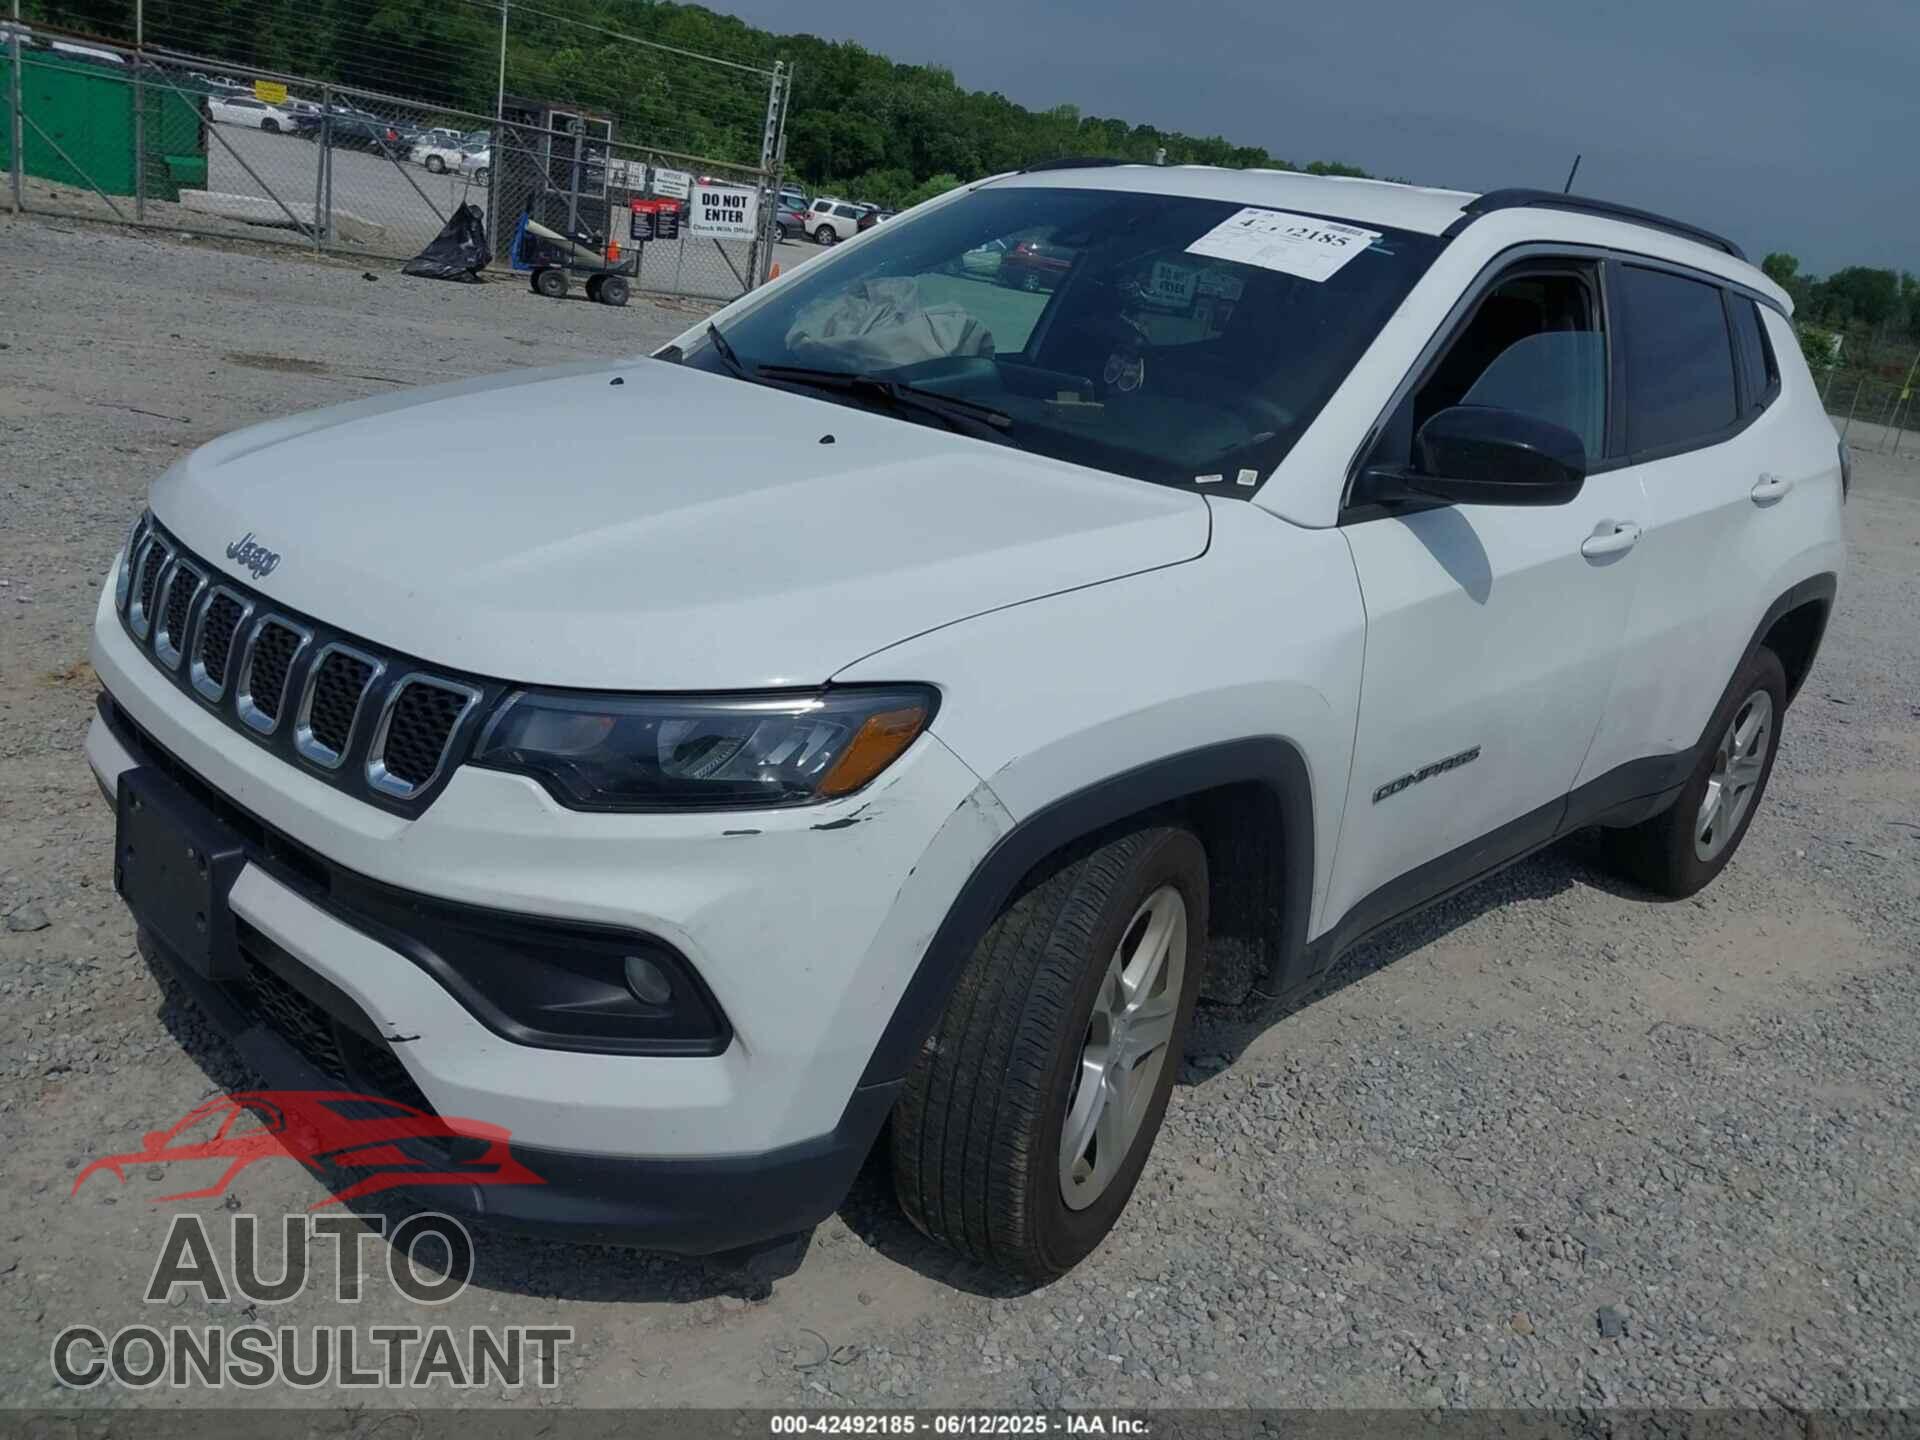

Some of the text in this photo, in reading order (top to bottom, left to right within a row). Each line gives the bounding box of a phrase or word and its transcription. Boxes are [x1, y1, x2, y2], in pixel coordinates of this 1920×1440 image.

[702, 193, 748, 208] DO NOT
[705, 209, 743, 223] ENTER
[227, 532, 281, 580] Jeep
